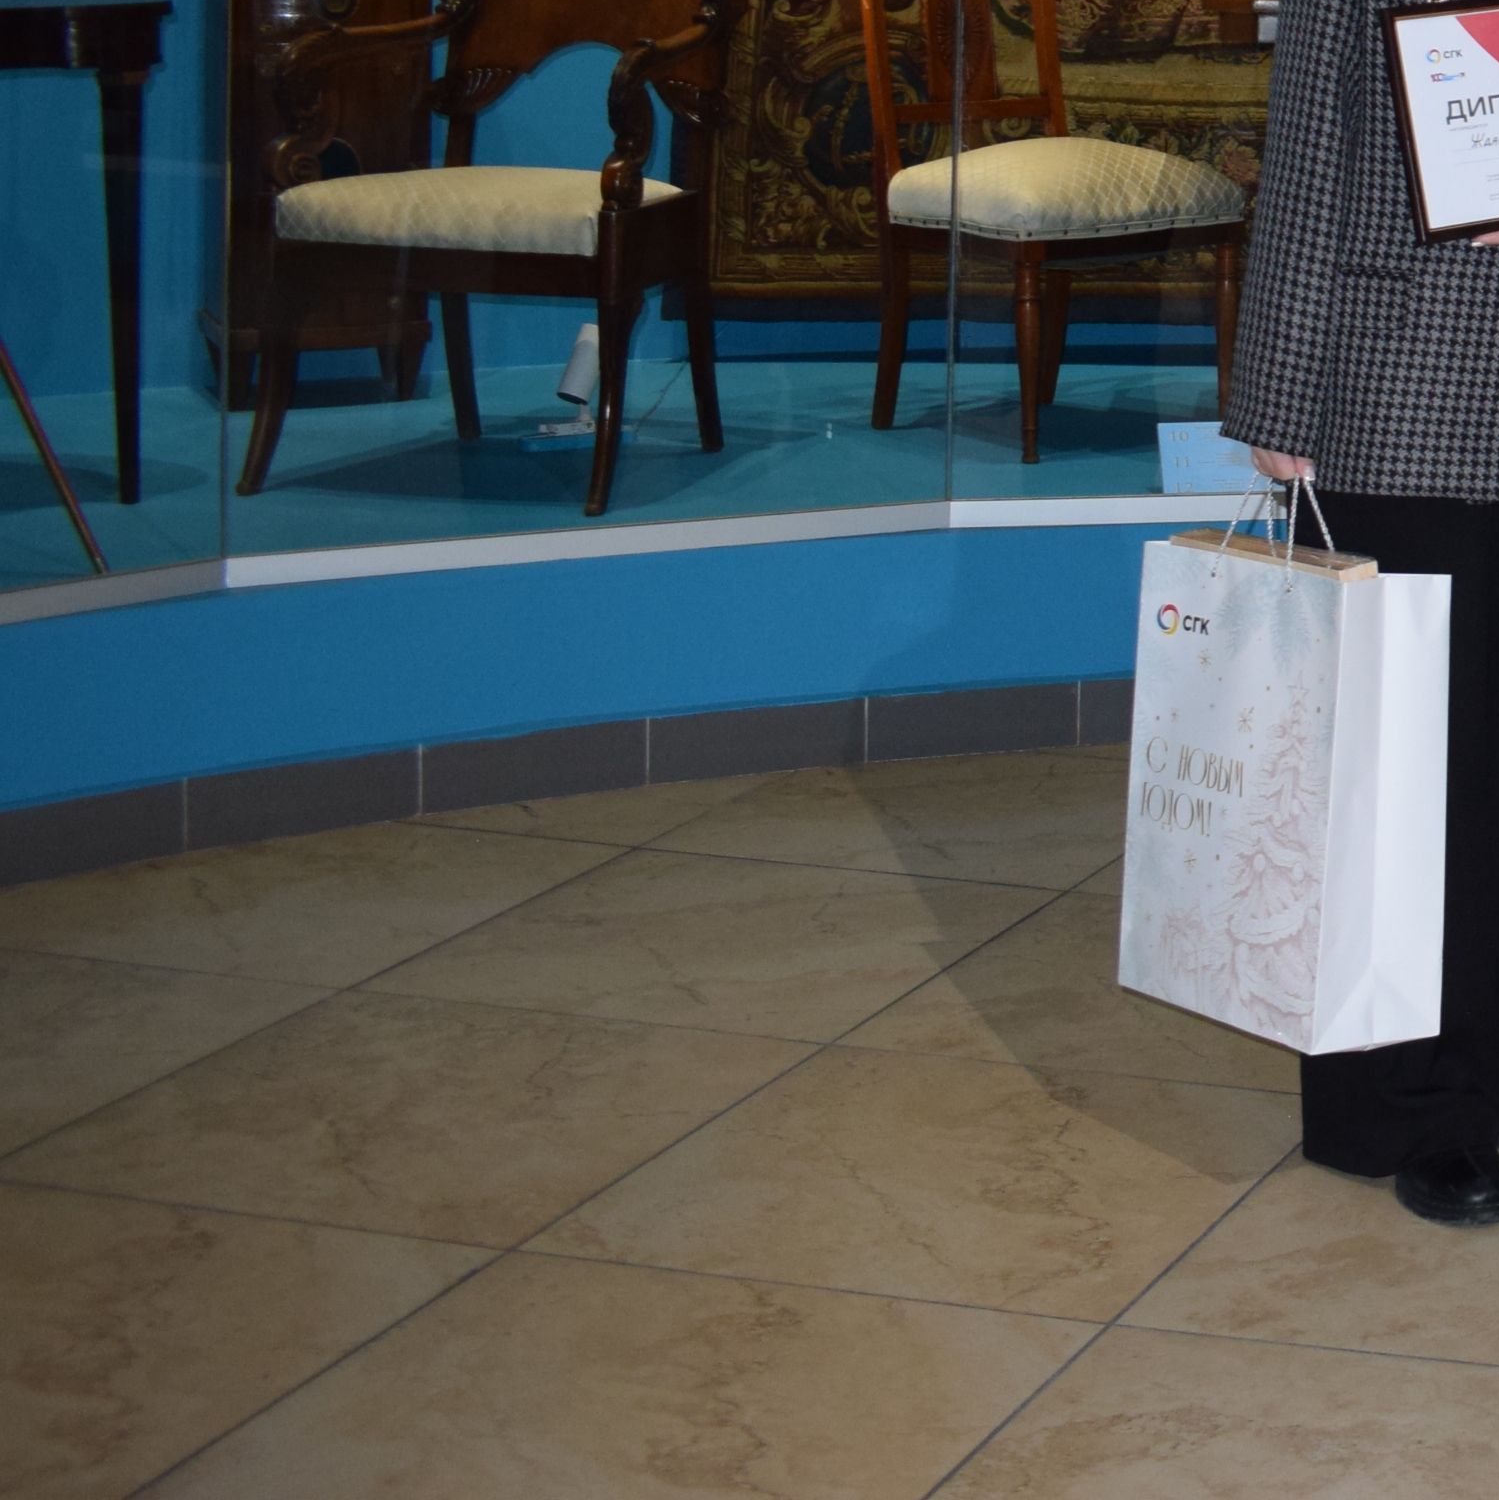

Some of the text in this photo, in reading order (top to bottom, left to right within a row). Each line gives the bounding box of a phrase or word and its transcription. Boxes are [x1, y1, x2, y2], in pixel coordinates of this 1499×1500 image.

[1443, 49, 1463, 59] СГК
[1182, 614, 1210, 635] СГК
[1146, 736, 1244, 798] С НОВЫМ
[1140, 781, 1212, 838] ГОДОМ!
